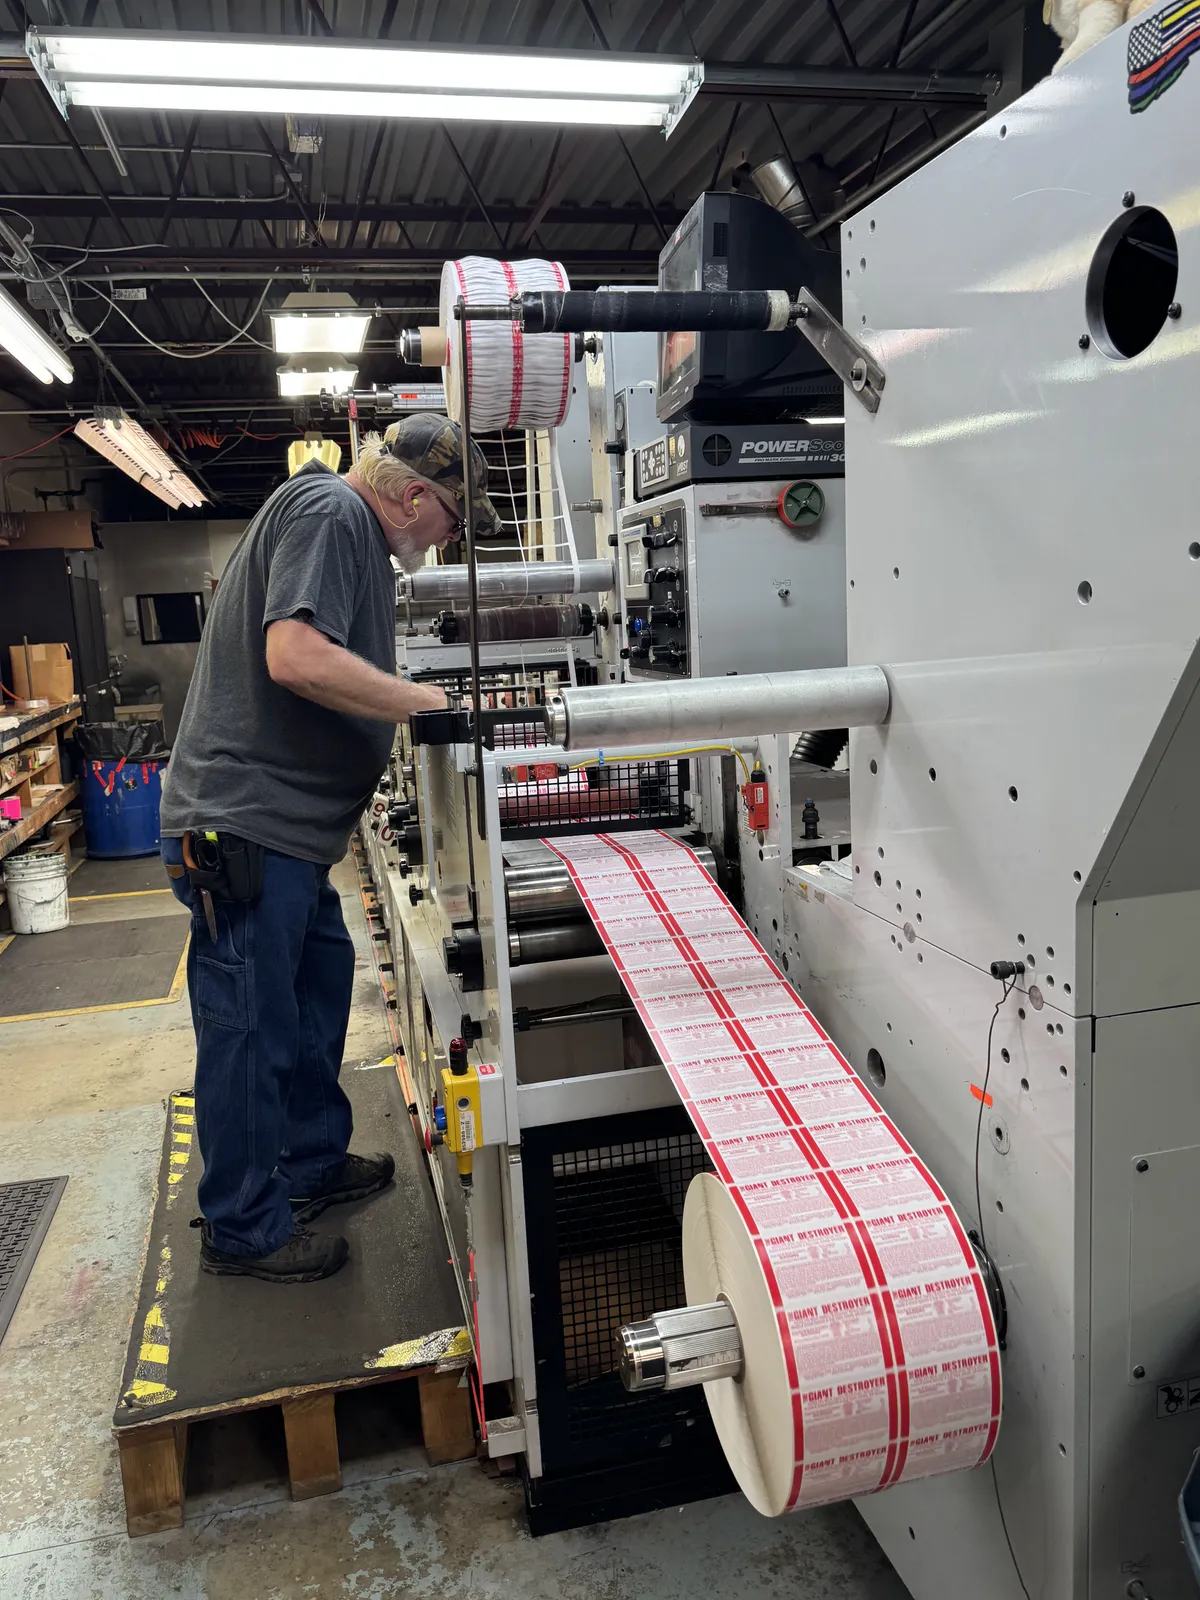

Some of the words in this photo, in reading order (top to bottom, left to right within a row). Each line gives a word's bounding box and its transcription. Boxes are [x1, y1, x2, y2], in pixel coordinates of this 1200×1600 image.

[741, 439, 845, 454] POWERSco
[724, 1091, 765, 1100] DESTROYER
[813, 1123, 835, 1131] GIANT
[838, 1117, 880, 1127] DESTROYER
[722, 1137, 743, 1146] GIANT
[746, 1131, 789, 1141] DESTROYER
[841, 1166, 864, 1175] GIANT
[866, 1158, 910, 1170] DESTROYER
[744, 1182, 767, 1191] GIANT
[771, 1174, 816, 1186] DESTROYER
[871, 1216, 895, 1226] GIANT
[897, 1207, 943, 1221] DESTROYER
[770, 1234, 794, 1245] GIANT
[797, 1225, 845, 1240] DESTROYER
[897, 1286, 921, 1298] GIANT
[925, 1276, 971, 1292] DESTROYER
[793, 1307, 818, 1320] GIANT
[822, 1296, 870, 1314] DESTROYER
[914, 1366, 937, 1378] GIANT
[941, 1354, 988, 1372] DESTROYER
[808, 1388, 833, 1401] GIANT
[837, 1377, 885, 1395] DESTROYER
[915, 1435, 939, 1446] GIANT
[943, 1423, 988, 1439] DESTROYER
[810, 1458, 835, 1470] GIANT
[839, 1447, 886, 1463] DESTROYER
